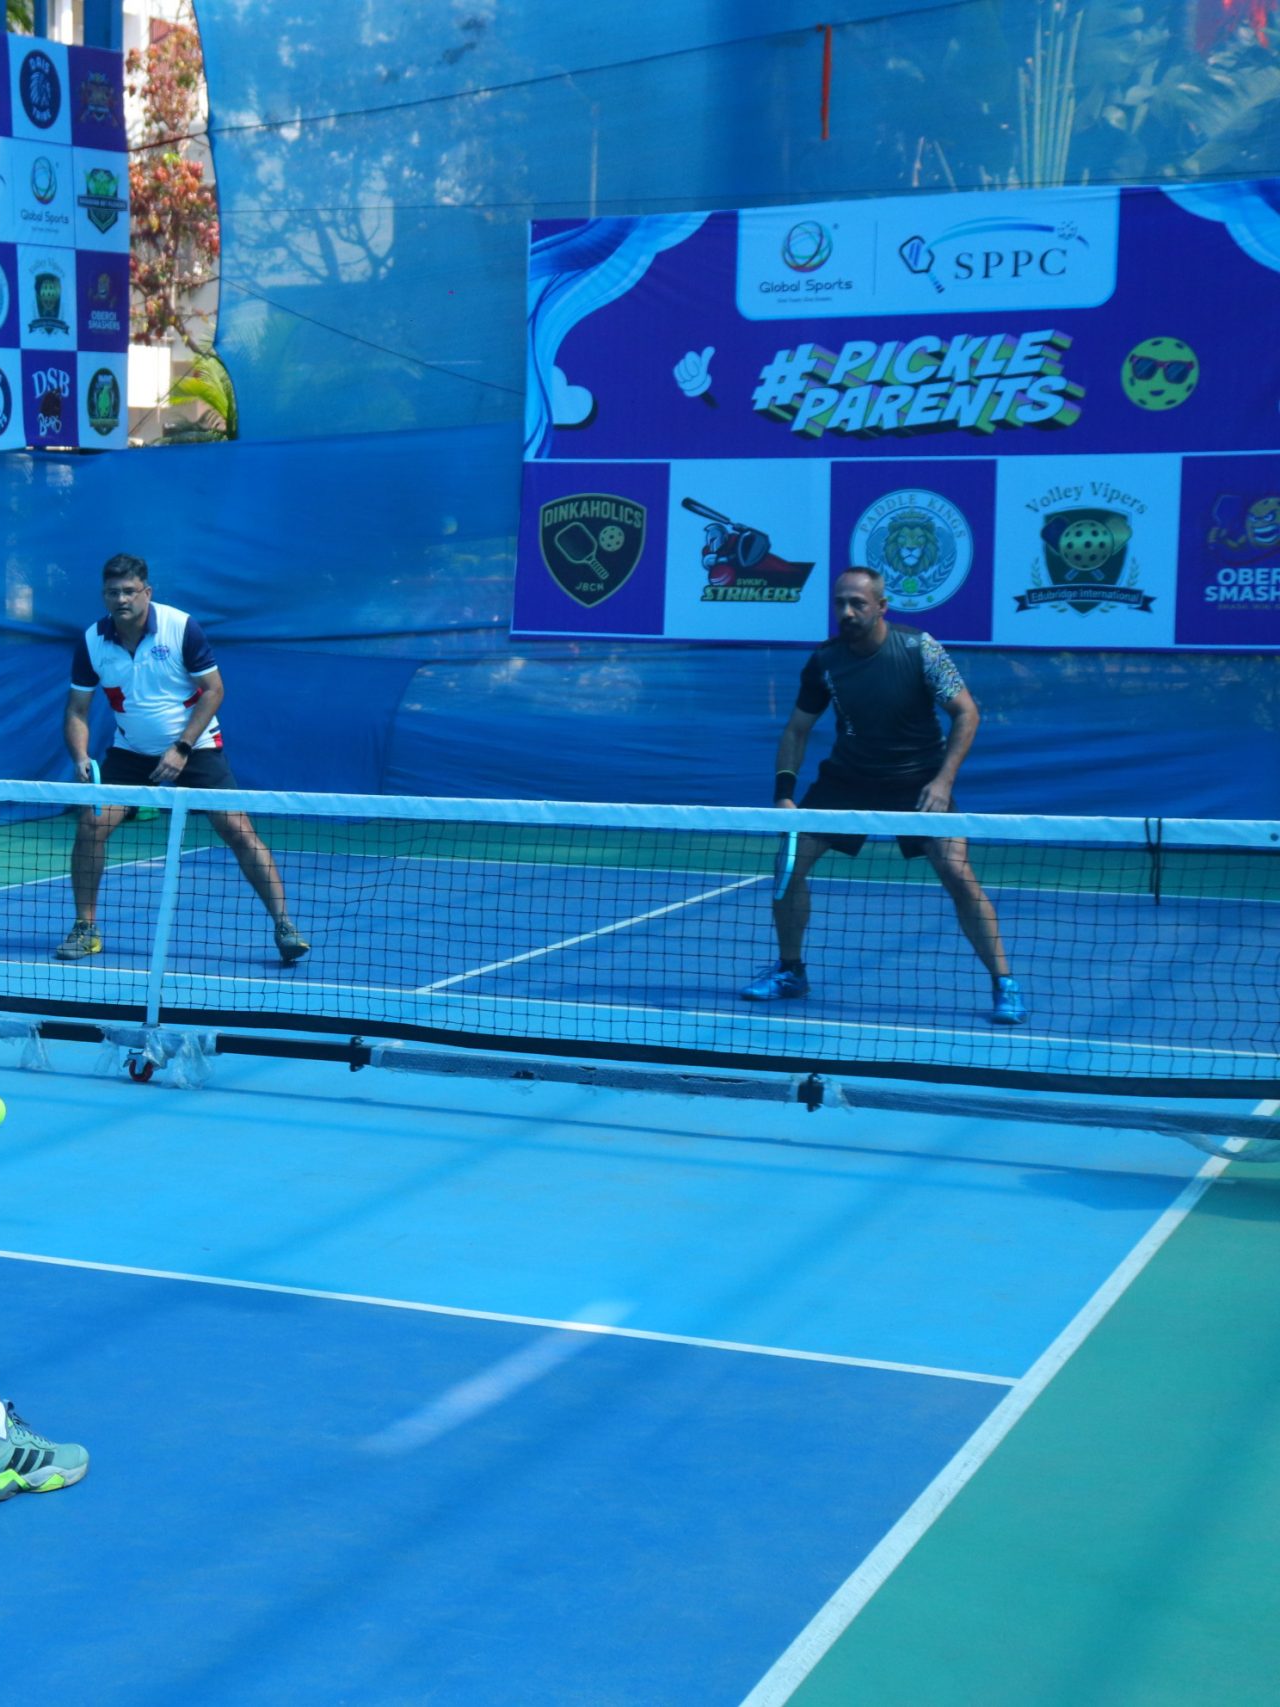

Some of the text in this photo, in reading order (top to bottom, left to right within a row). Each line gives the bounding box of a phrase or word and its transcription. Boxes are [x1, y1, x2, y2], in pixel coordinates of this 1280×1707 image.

[44, 210, 70, 225] Sports
[954, 247, 1069, 280] SPPC
[759, 277, 853, 293] Global Sports
[31, 367, 70, 398] DSB
[751, 329, 1060, 411] #PICKLE
[790, 375, 1070, 433] PARENTS
[1025, 481, 1148, 515] Volley Vipers
[543, 500, 643, 529] DINKAHOLICS
[860, 494, 967, 538] PADDLE KINGS
[702, 585, 803, 602] STRIKERS
[1031, 588, 1078, 601] Edubridge
